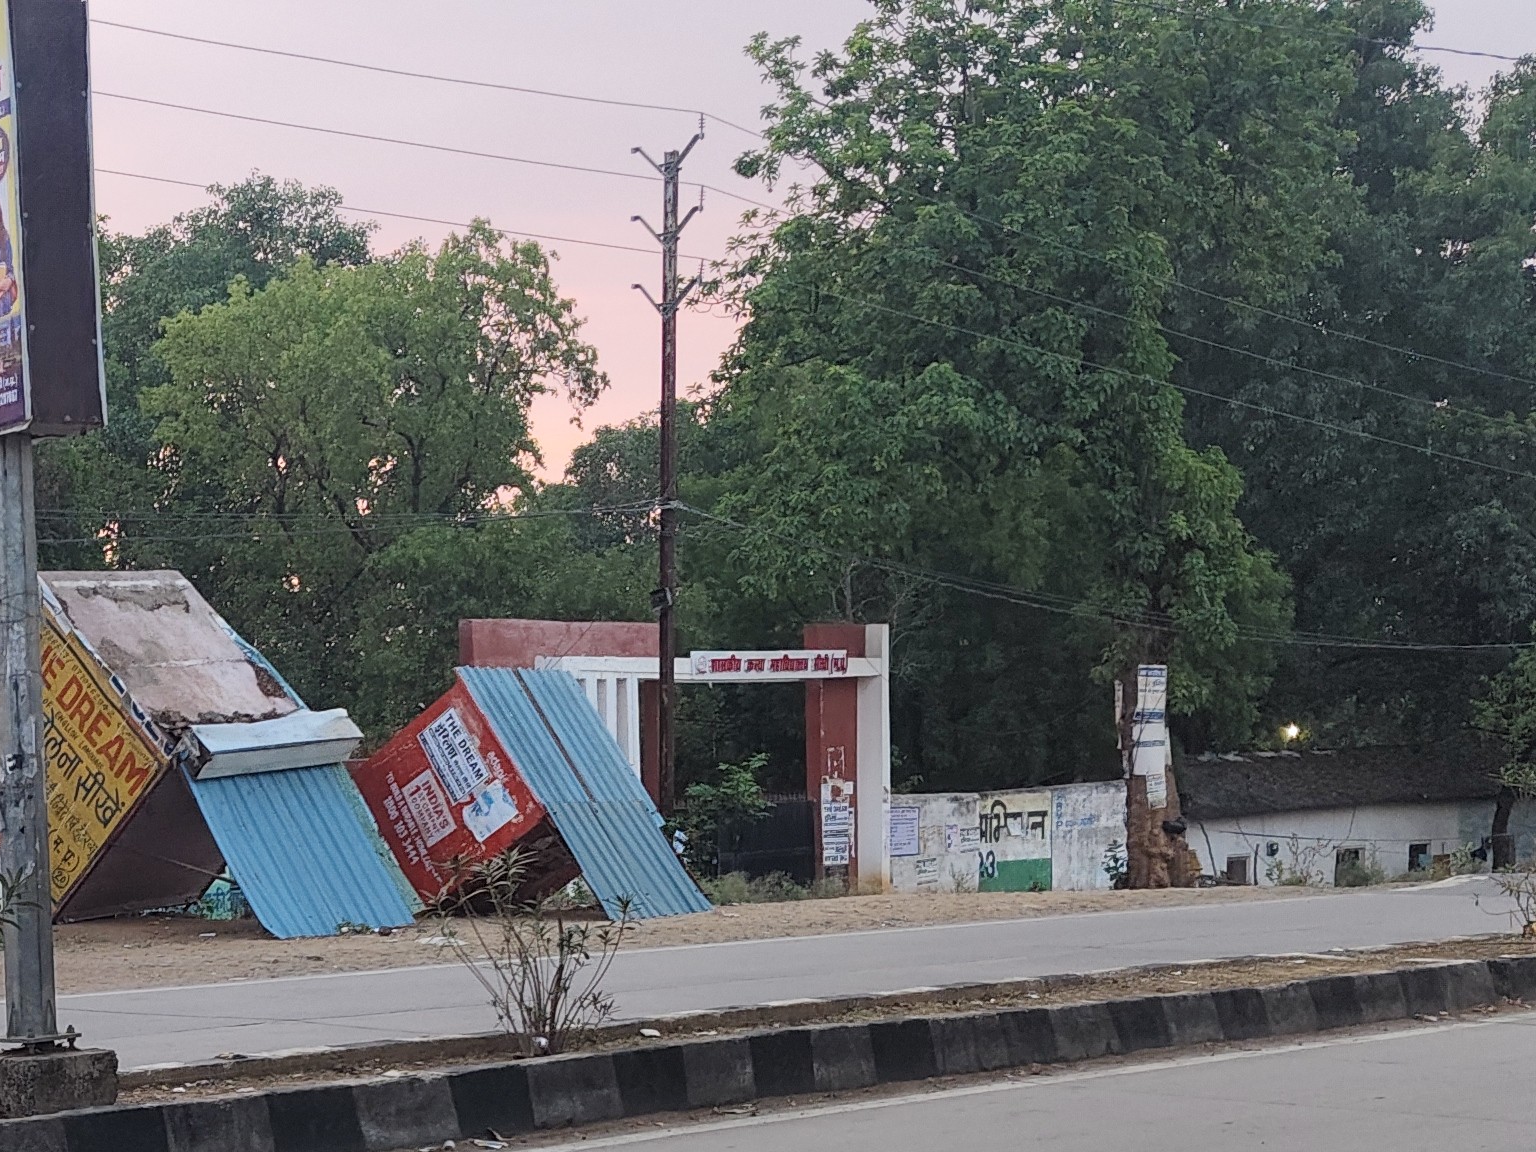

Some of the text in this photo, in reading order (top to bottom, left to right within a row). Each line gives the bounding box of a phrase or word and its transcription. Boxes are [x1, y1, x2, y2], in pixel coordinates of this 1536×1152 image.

[56, 674, 150, 796] DREAM
[444, 713, 464, 742] THE
[457, 739, 484, 781] DREAM
[421, 780, 449, 829] INDIA'S
